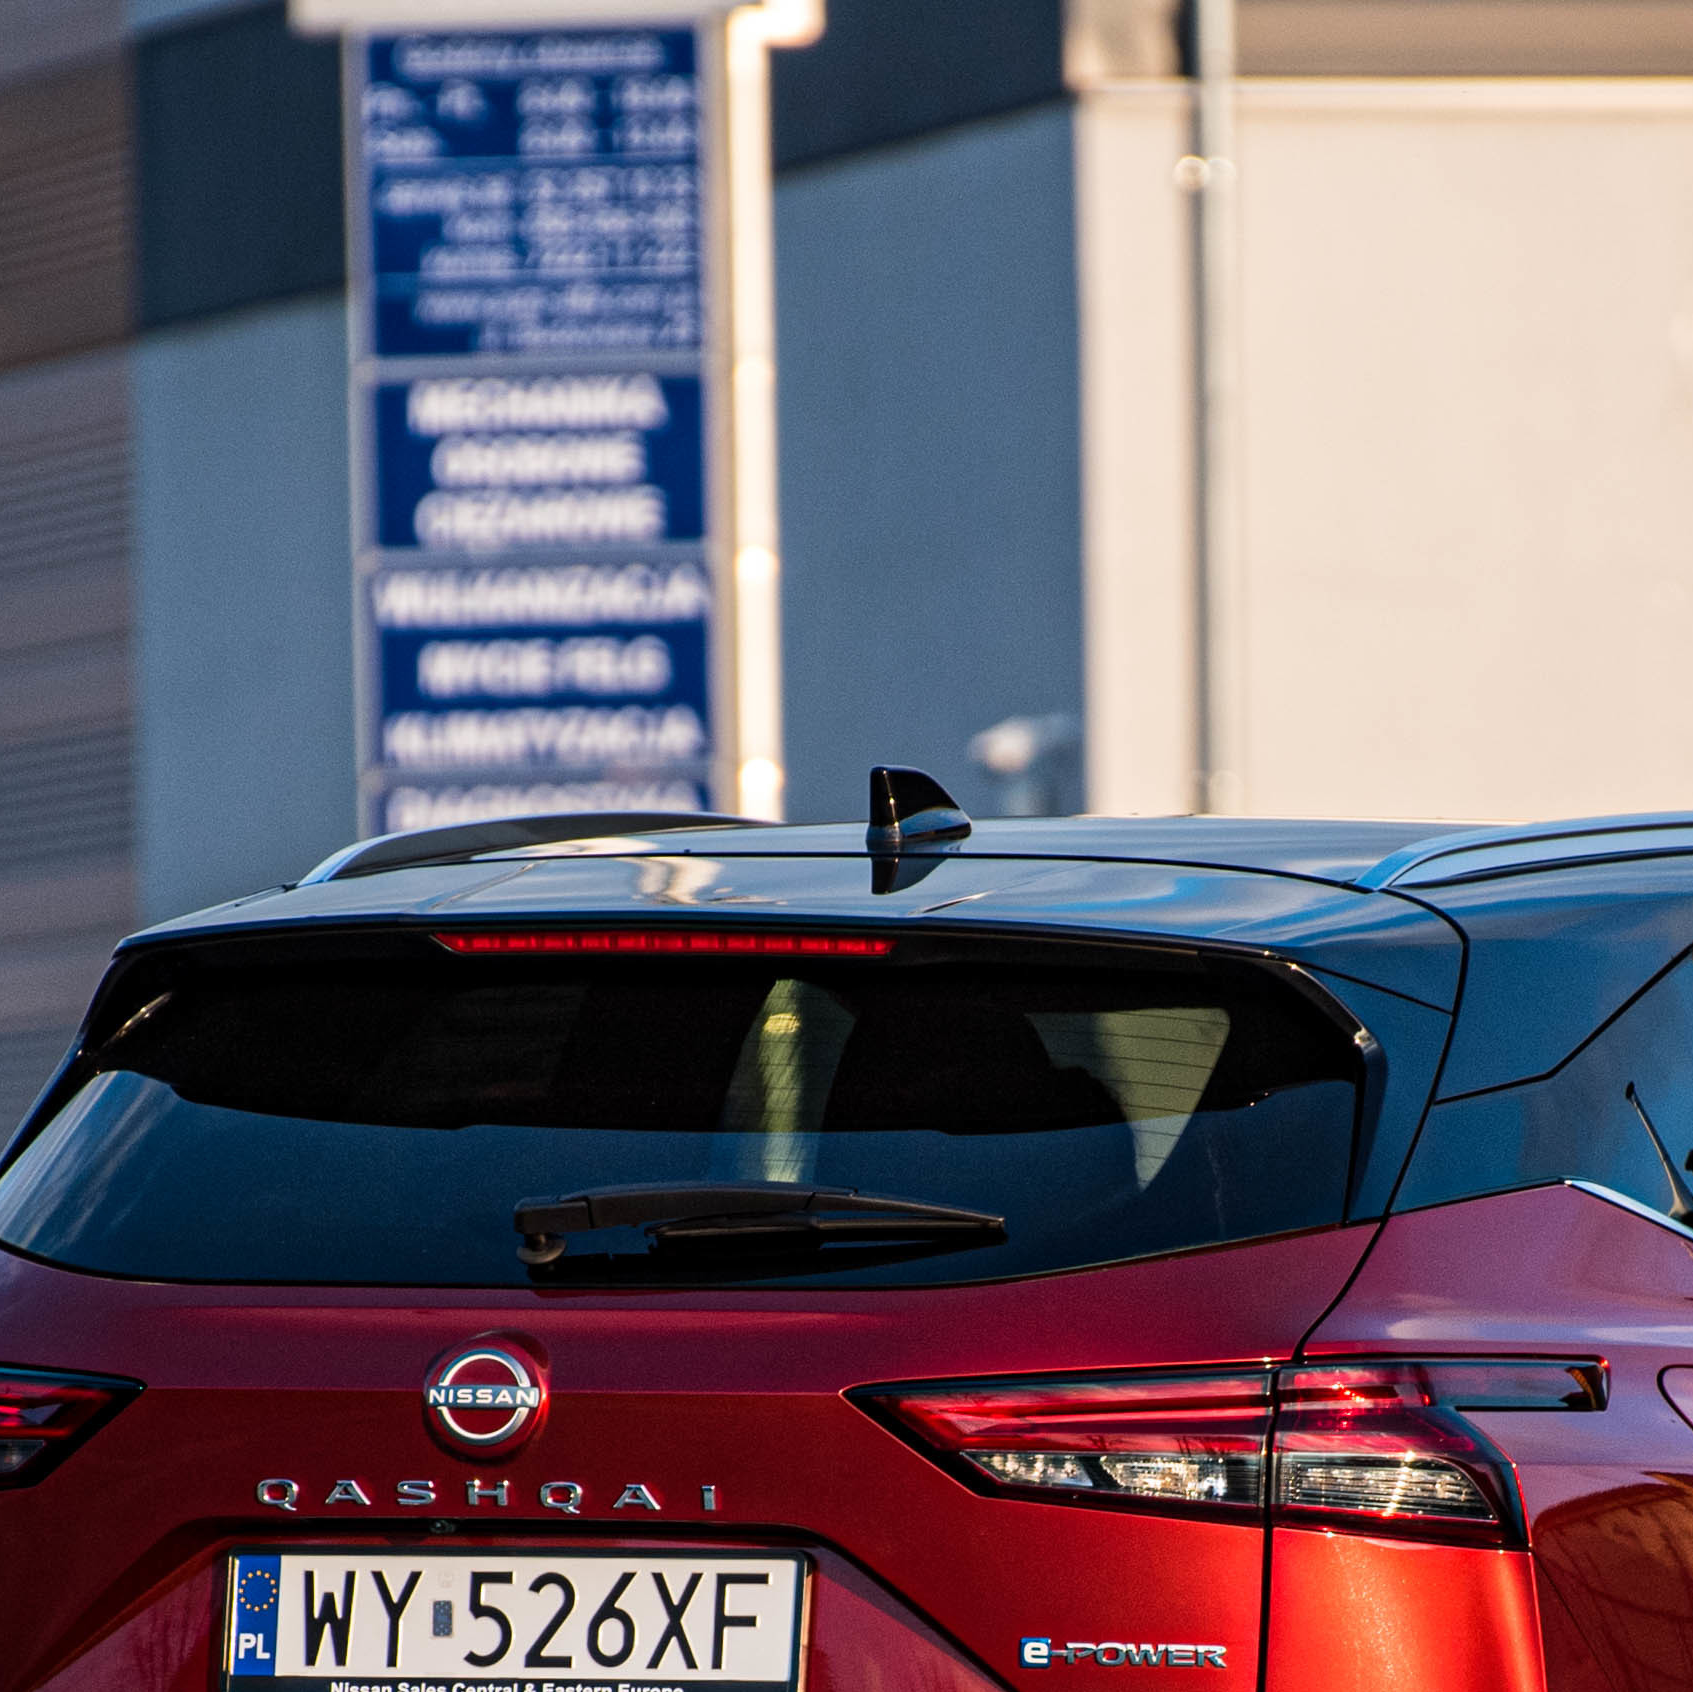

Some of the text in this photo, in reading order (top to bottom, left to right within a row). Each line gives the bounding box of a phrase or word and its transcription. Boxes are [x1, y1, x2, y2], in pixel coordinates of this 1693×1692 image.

[428, 1388, 536, 1405] NISSAN
[256, 1478, 716, 1514] QASHQAI
[304, 1570, 770, 1670] WY 526XF
[237, 1632, 271, 1660] PL
[1021, 1639, 1228, 1668] e-POWER
